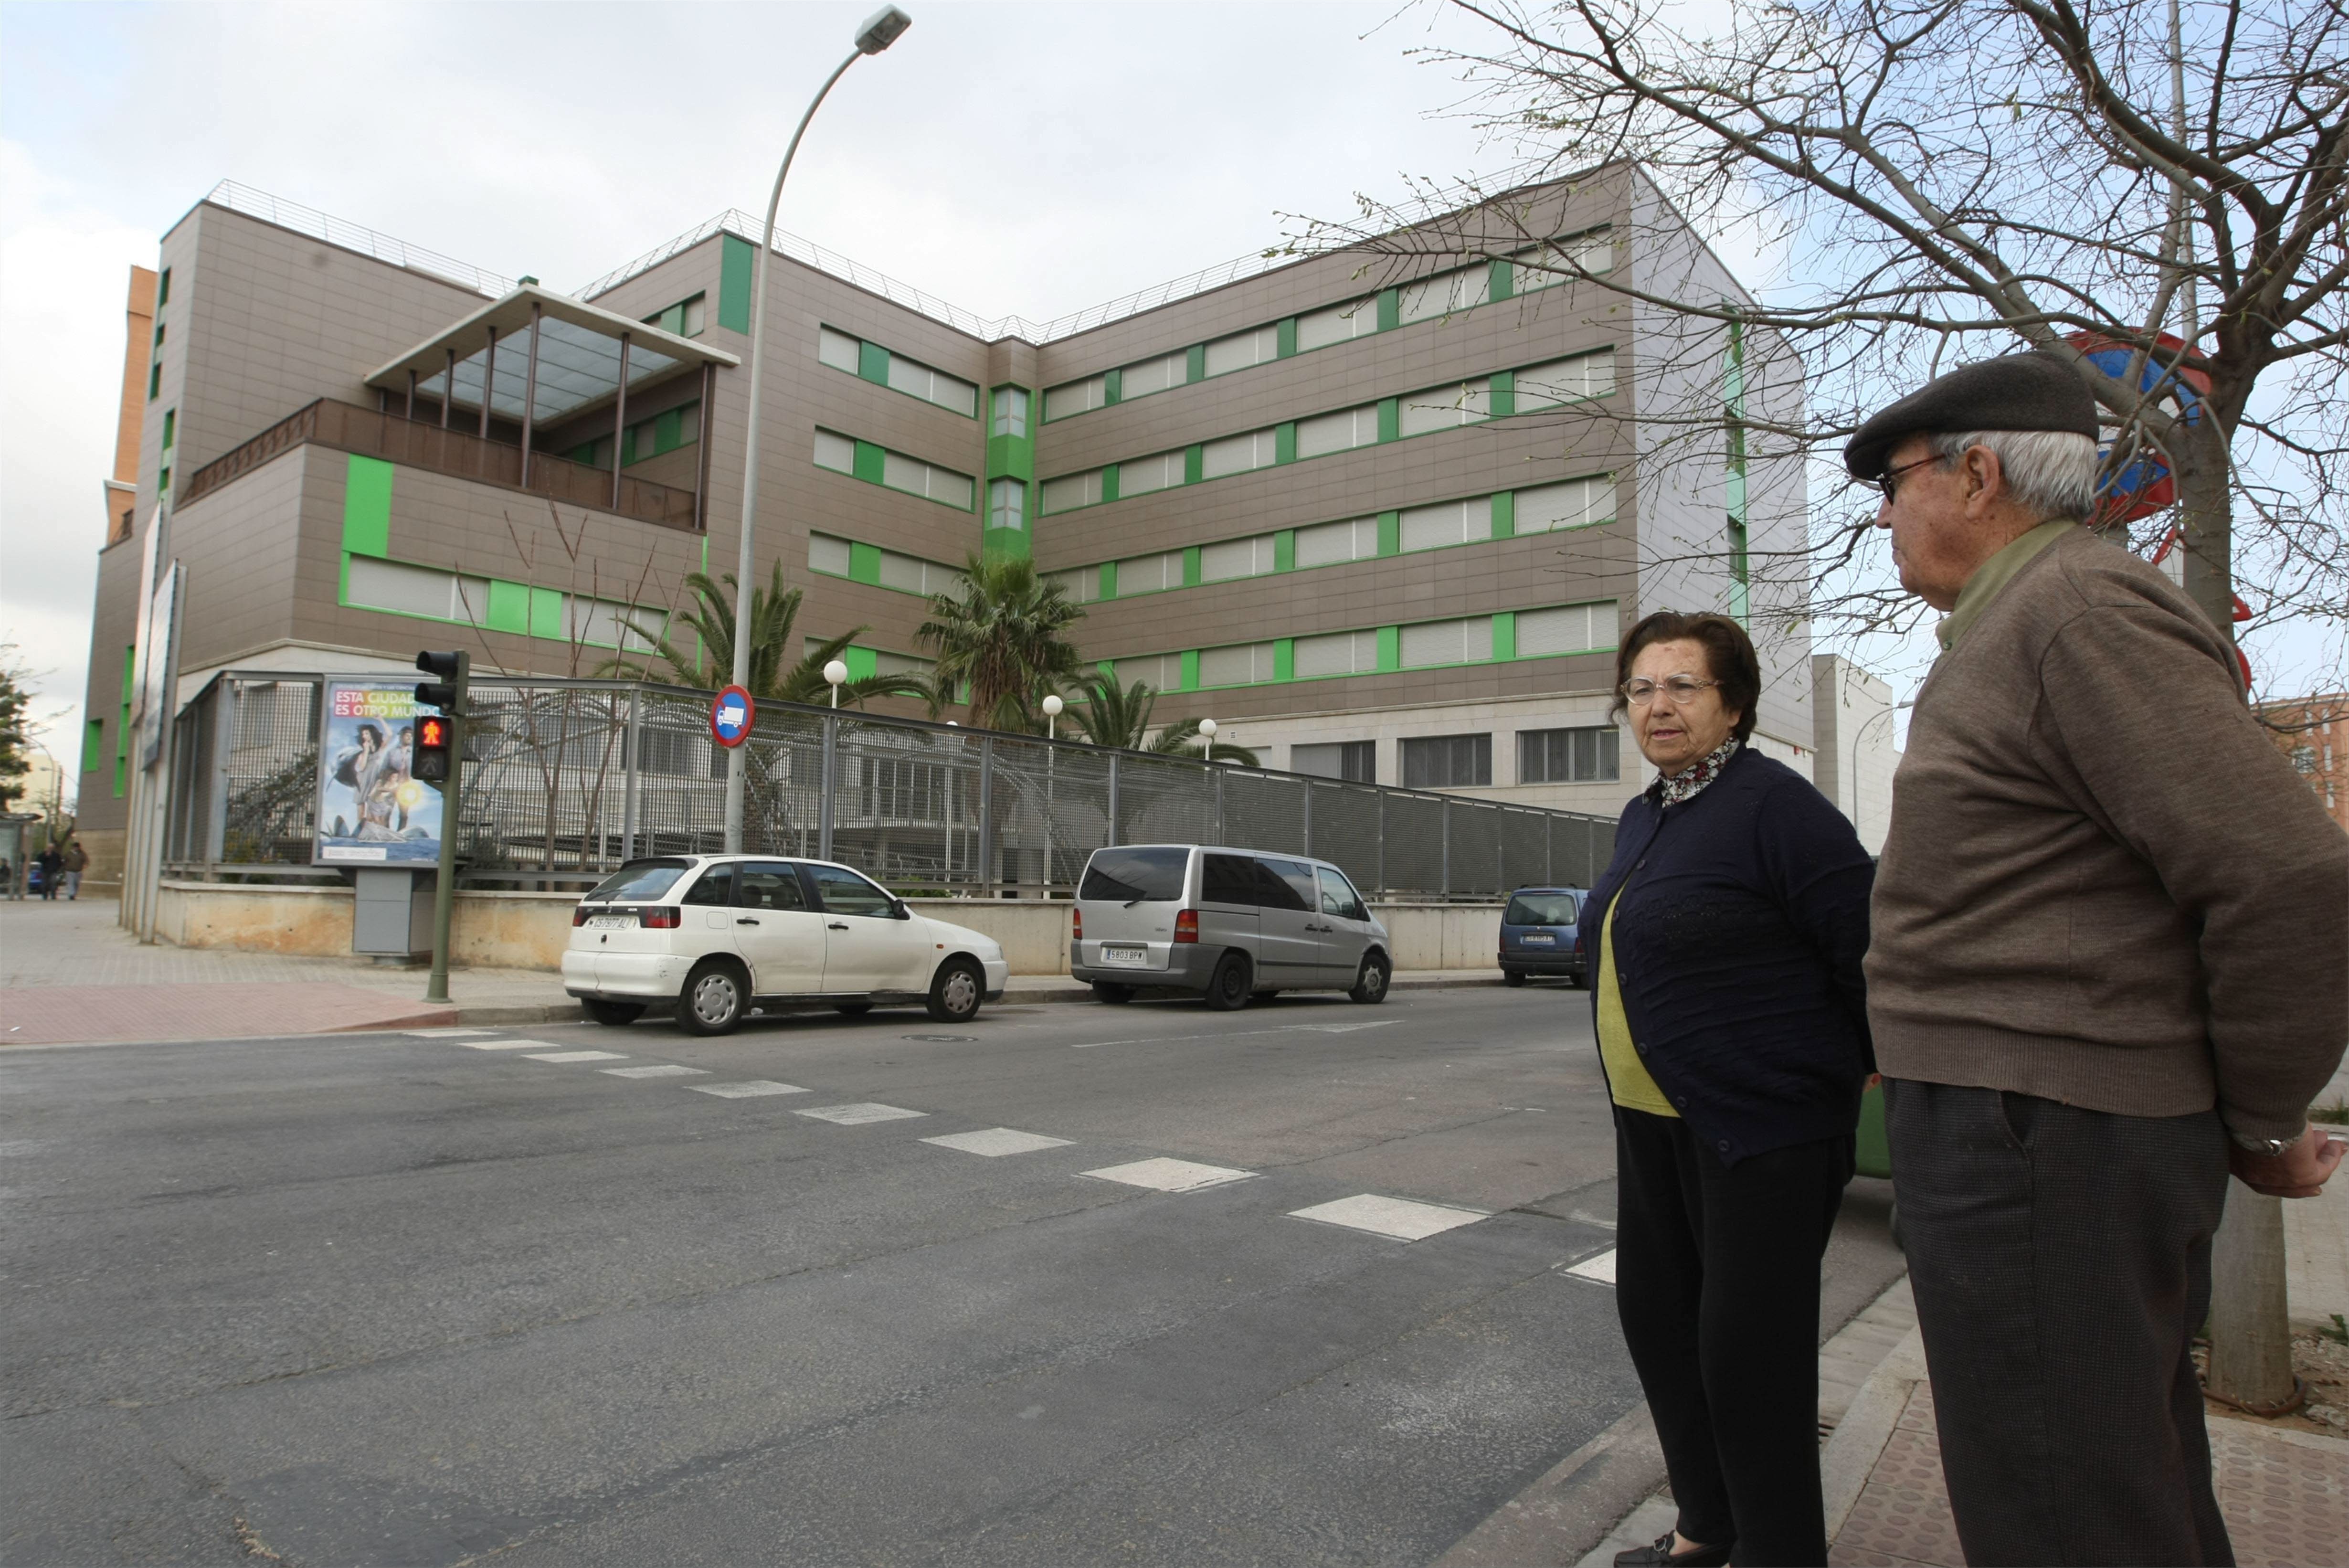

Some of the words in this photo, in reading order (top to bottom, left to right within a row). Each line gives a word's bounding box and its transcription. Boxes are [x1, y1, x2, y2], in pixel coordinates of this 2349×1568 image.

[336, 692, 363, 703] ESTA
[368, 693, 415, 703] CIUDAD
[335, 704, 349, 715] ES
[353, 705, 388, 716] OTRO
[392, 706, 440, 716] MUNDO
[1111, 951, 1128, 959] 5803
